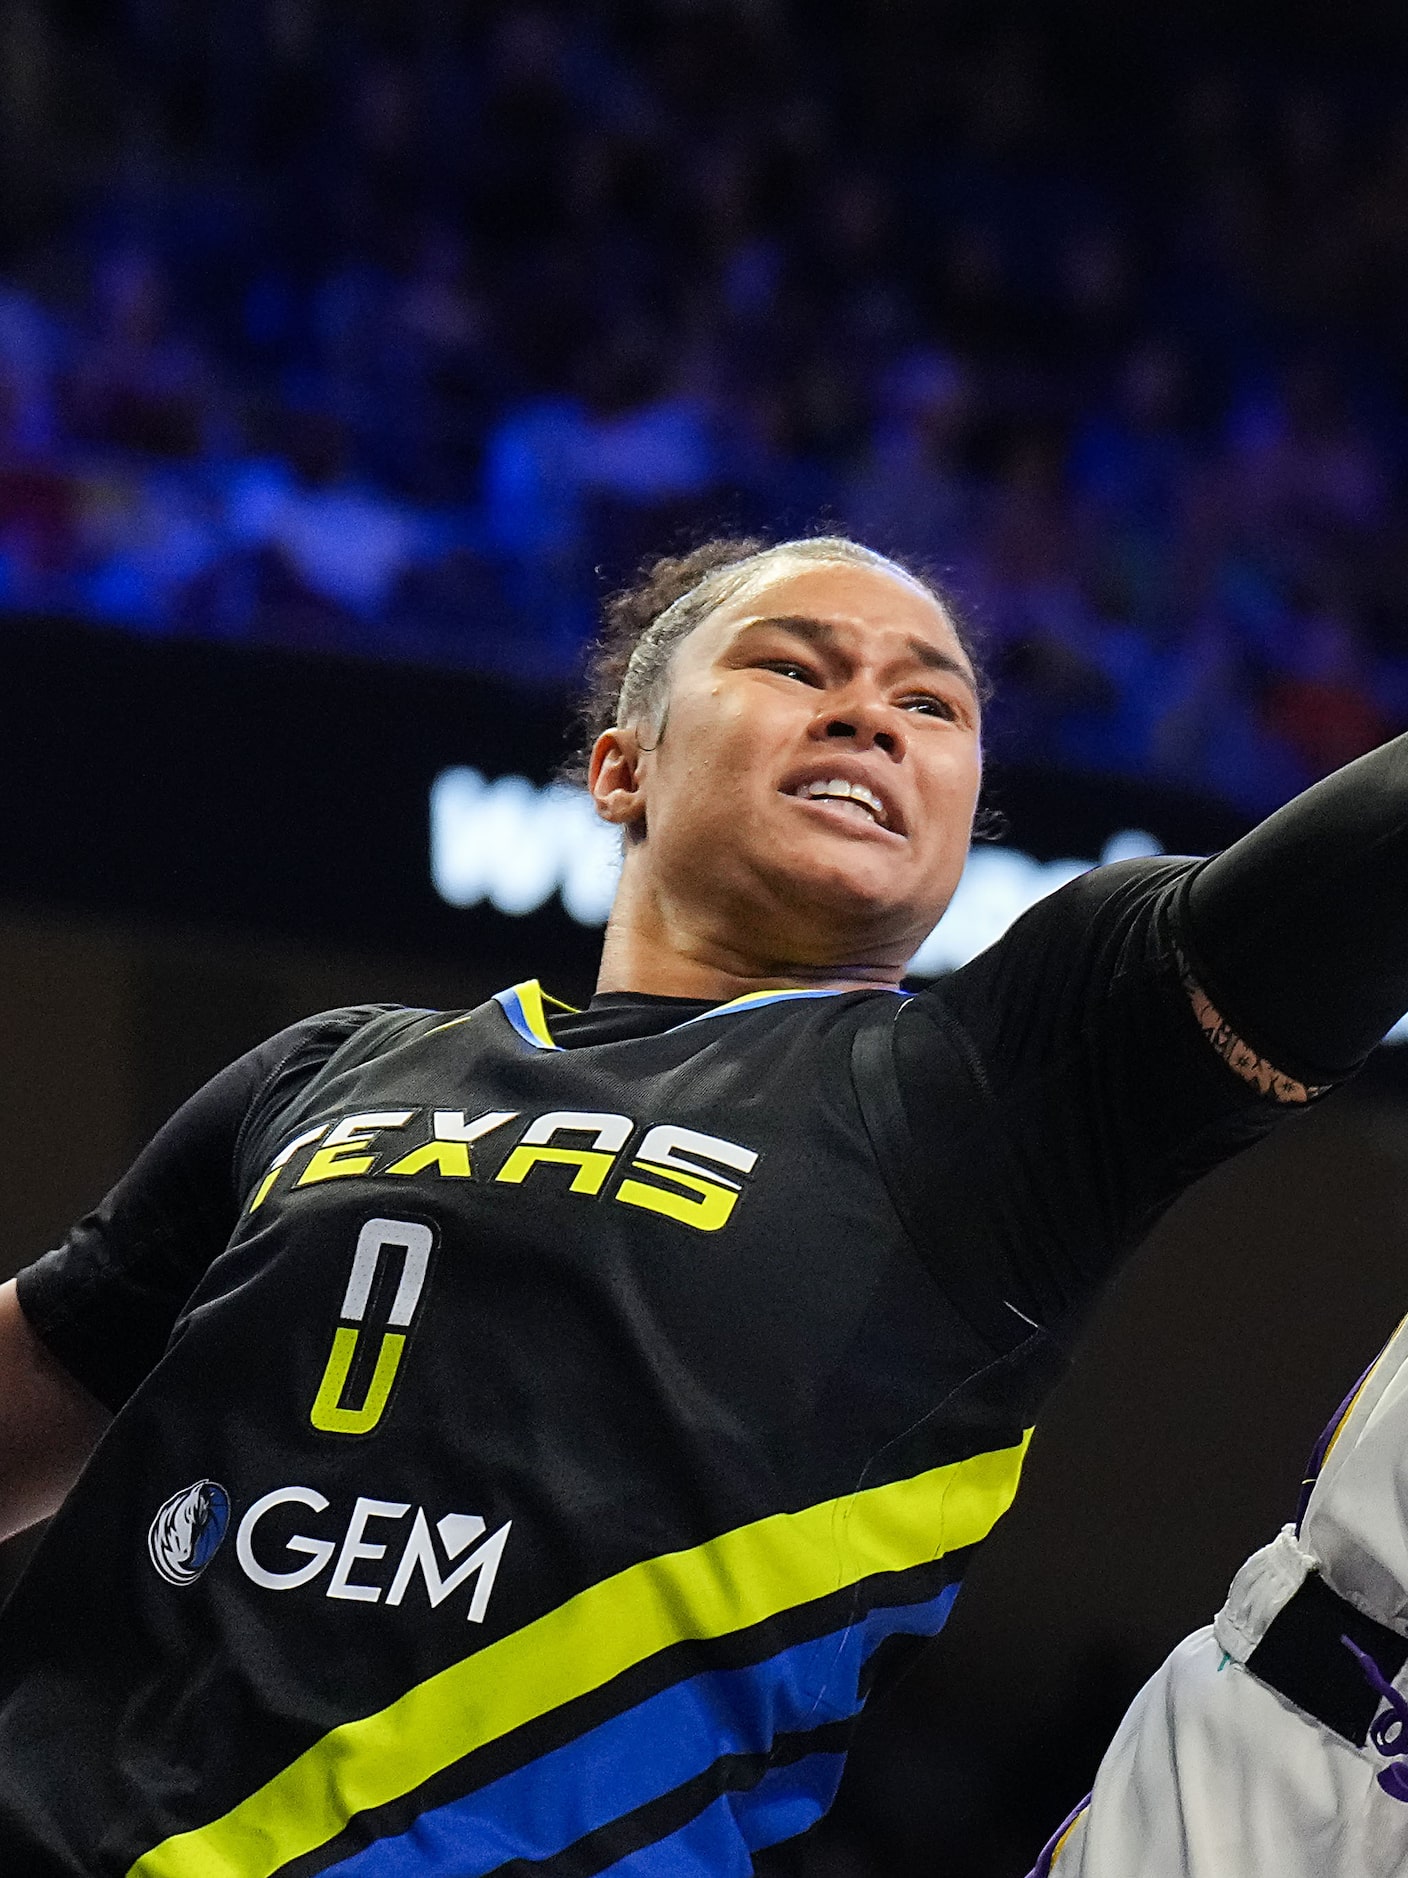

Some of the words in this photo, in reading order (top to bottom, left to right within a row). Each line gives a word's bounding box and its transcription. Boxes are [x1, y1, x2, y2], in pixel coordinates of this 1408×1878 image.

[250, 1109, 760, 1232] TEXAS
[310, 1217, 434, 1434] 0
[235, 1486, 513, 1625] GEM
